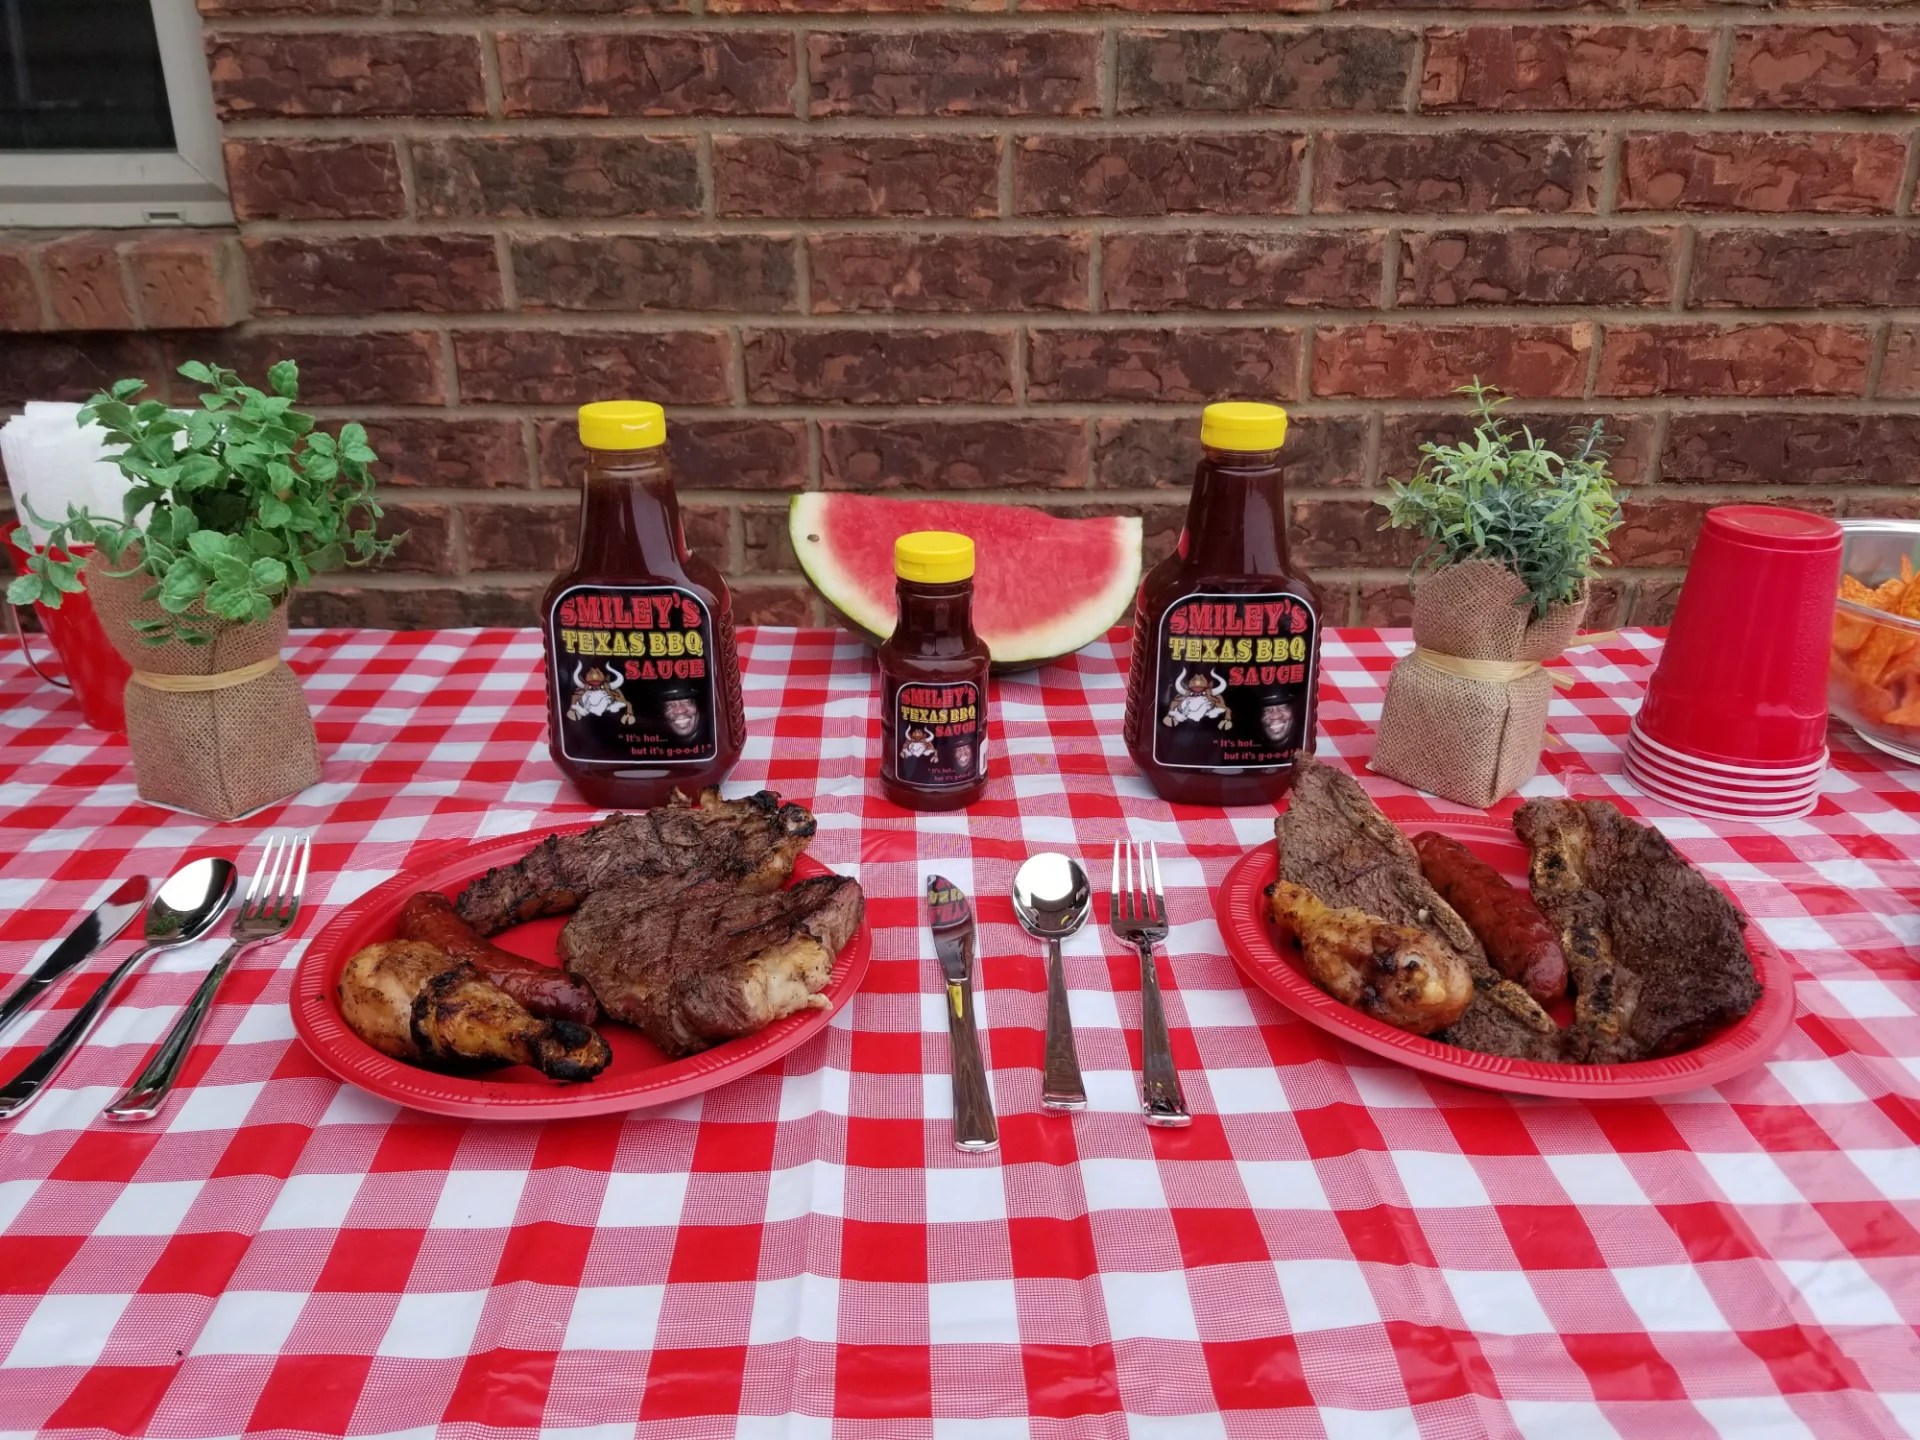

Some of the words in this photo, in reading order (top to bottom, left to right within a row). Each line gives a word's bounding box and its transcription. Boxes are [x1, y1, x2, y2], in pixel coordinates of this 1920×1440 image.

[560, 592, 701, 629] SMILEY'S
[1170, 599, 1308, 636] SMILEY'S
[562, 629, 646, 656] TEXAS
[648, 629, 704, 657] BBQ
[1168, 636, 1253, 663] TEXAS
[1255, 636, 1306, 663] BBQ
[624, 659, 706, 680] SAUCE
[1228, 663, 1305, 686] SAUCE
[902, 685, 976, 708] SMILEY'S
[902, 706, 948, 723] TEXAS
[950, 705, 976, 723] BBQ
[935, 721, 976, 737] SAUCE
[631, 747, 647, 755] but
[1223, 752, 1240, 760] but
